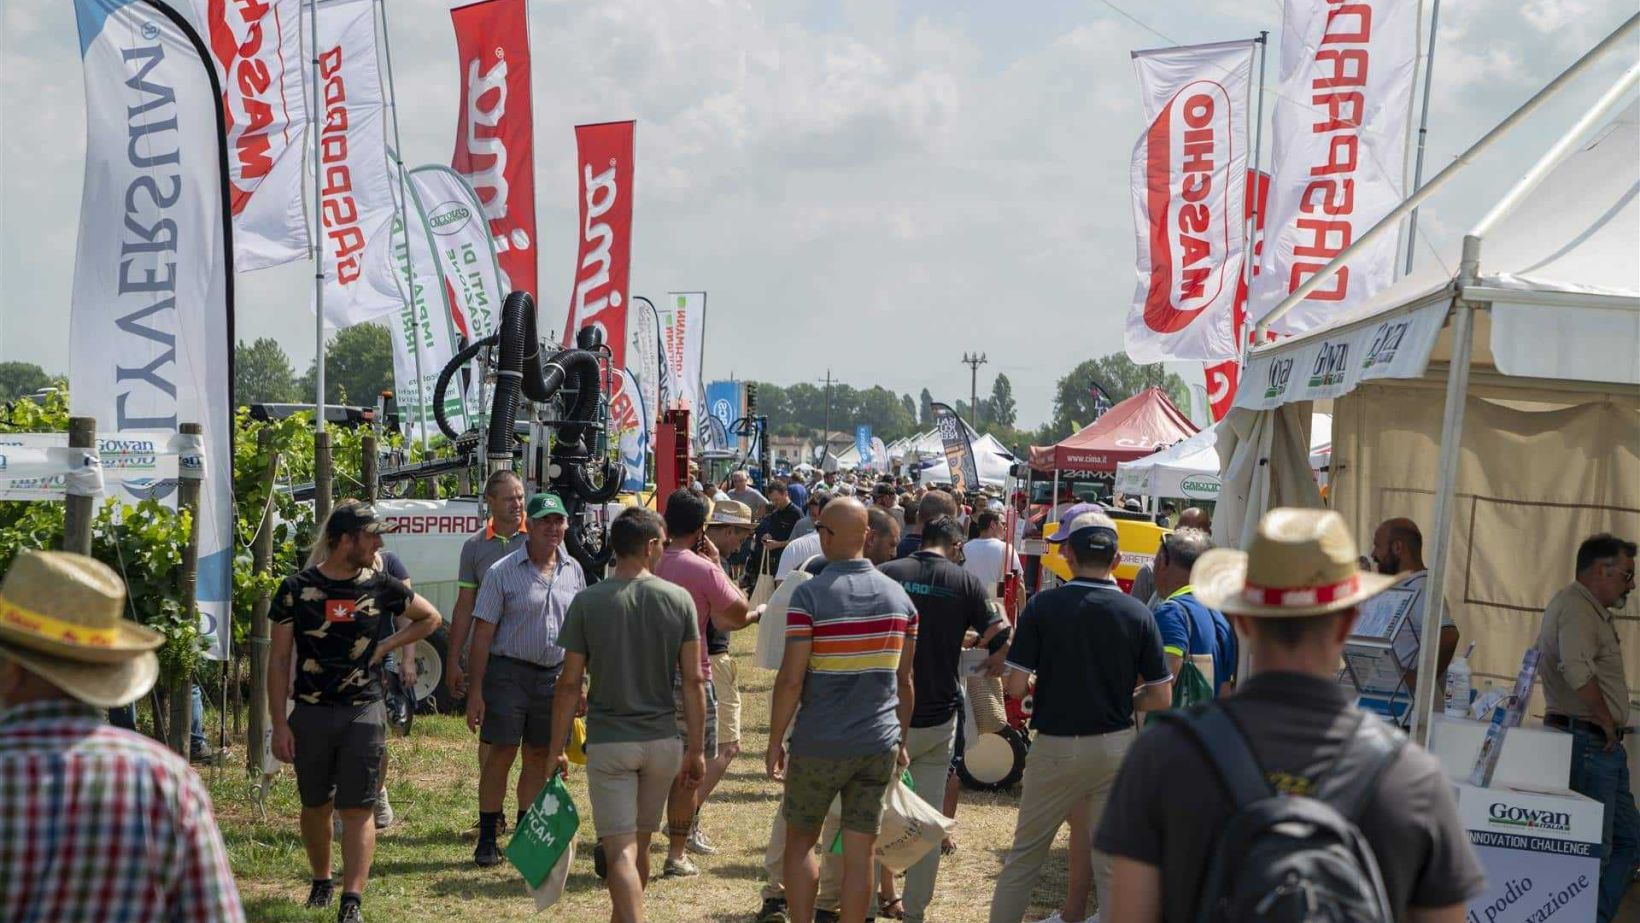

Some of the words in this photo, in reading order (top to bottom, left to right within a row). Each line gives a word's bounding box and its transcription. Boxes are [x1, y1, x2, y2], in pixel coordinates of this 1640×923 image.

[1066, 454, 1108, 464] www.cima.it
[386, 516, 480, 533] GASPARD
[1489, 802, 1572, 826] Gowan
[1468, 831, 1528, 848] NNOVATION
[1530, 838, 1591, 856] CHALLENGE
[1484, 877, 1533, 923] podio
